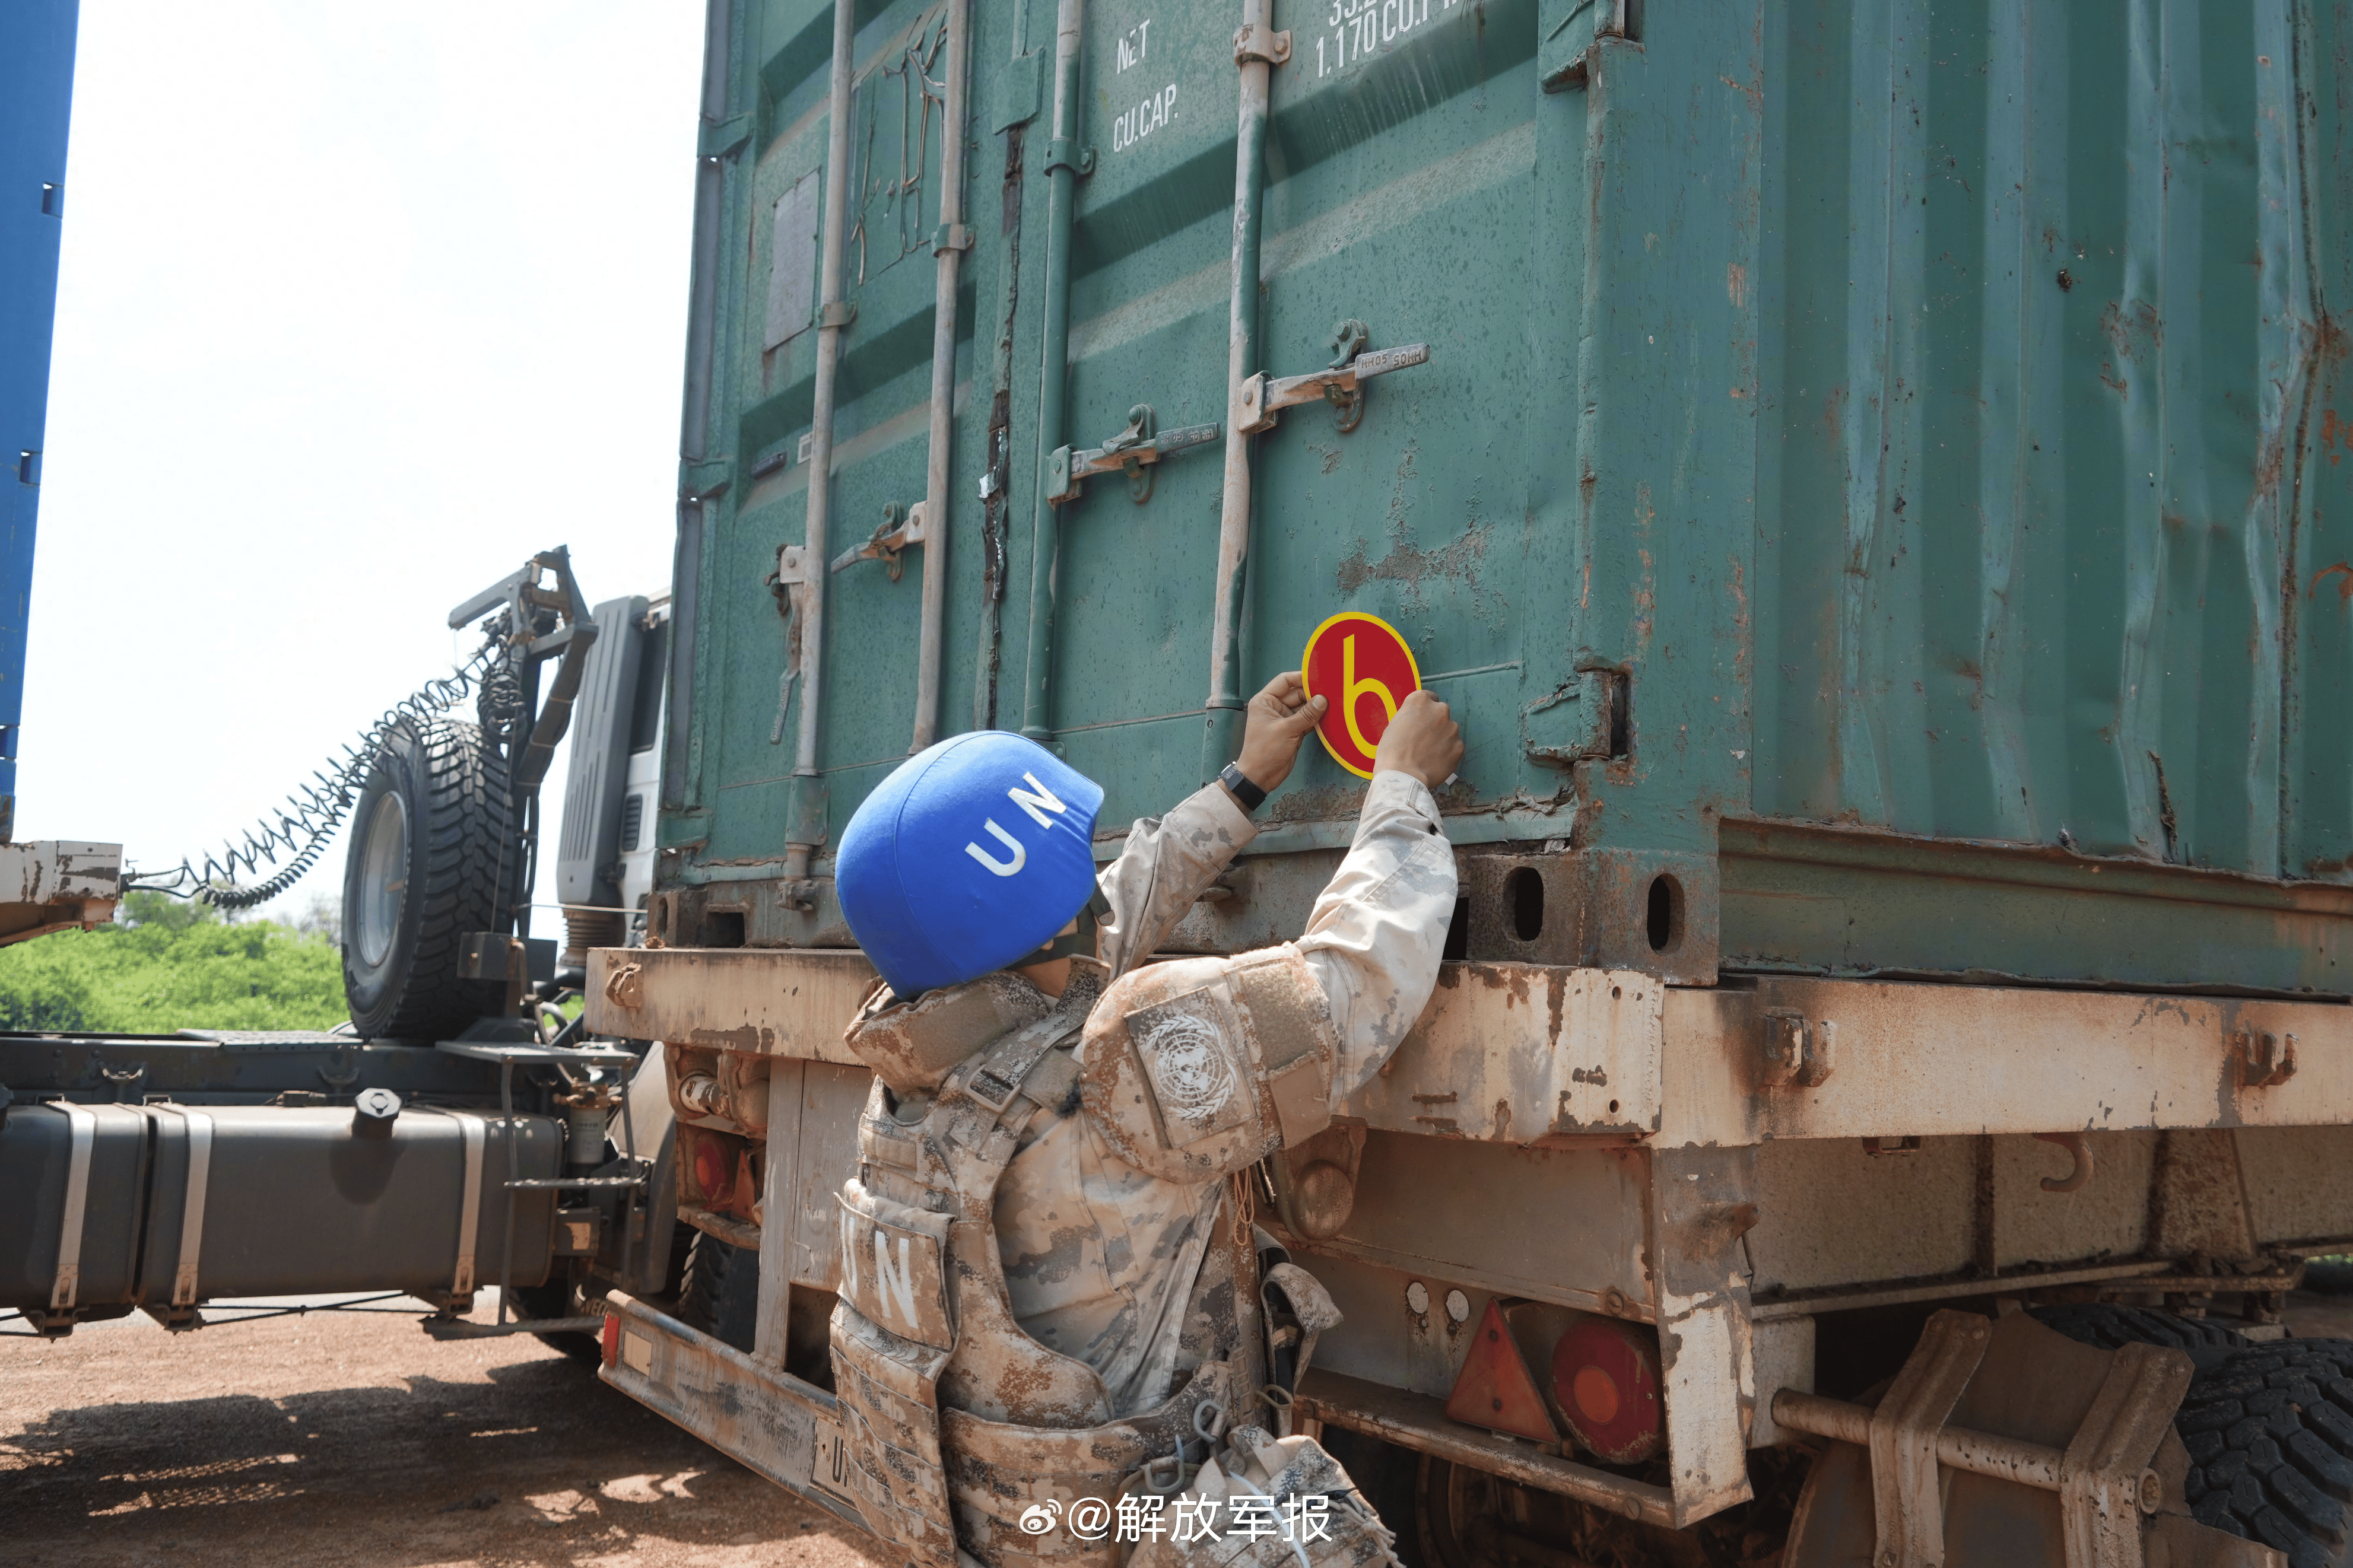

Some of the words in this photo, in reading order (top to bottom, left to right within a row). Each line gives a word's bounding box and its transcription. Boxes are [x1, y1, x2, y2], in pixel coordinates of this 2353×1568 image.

[1117, 19, 1151, 75] NET
[1113, 83, 1179, 153] CU.CAP.
[964, 771, 1067, 877] UN
[840, 1208, 919, 1330] UN
